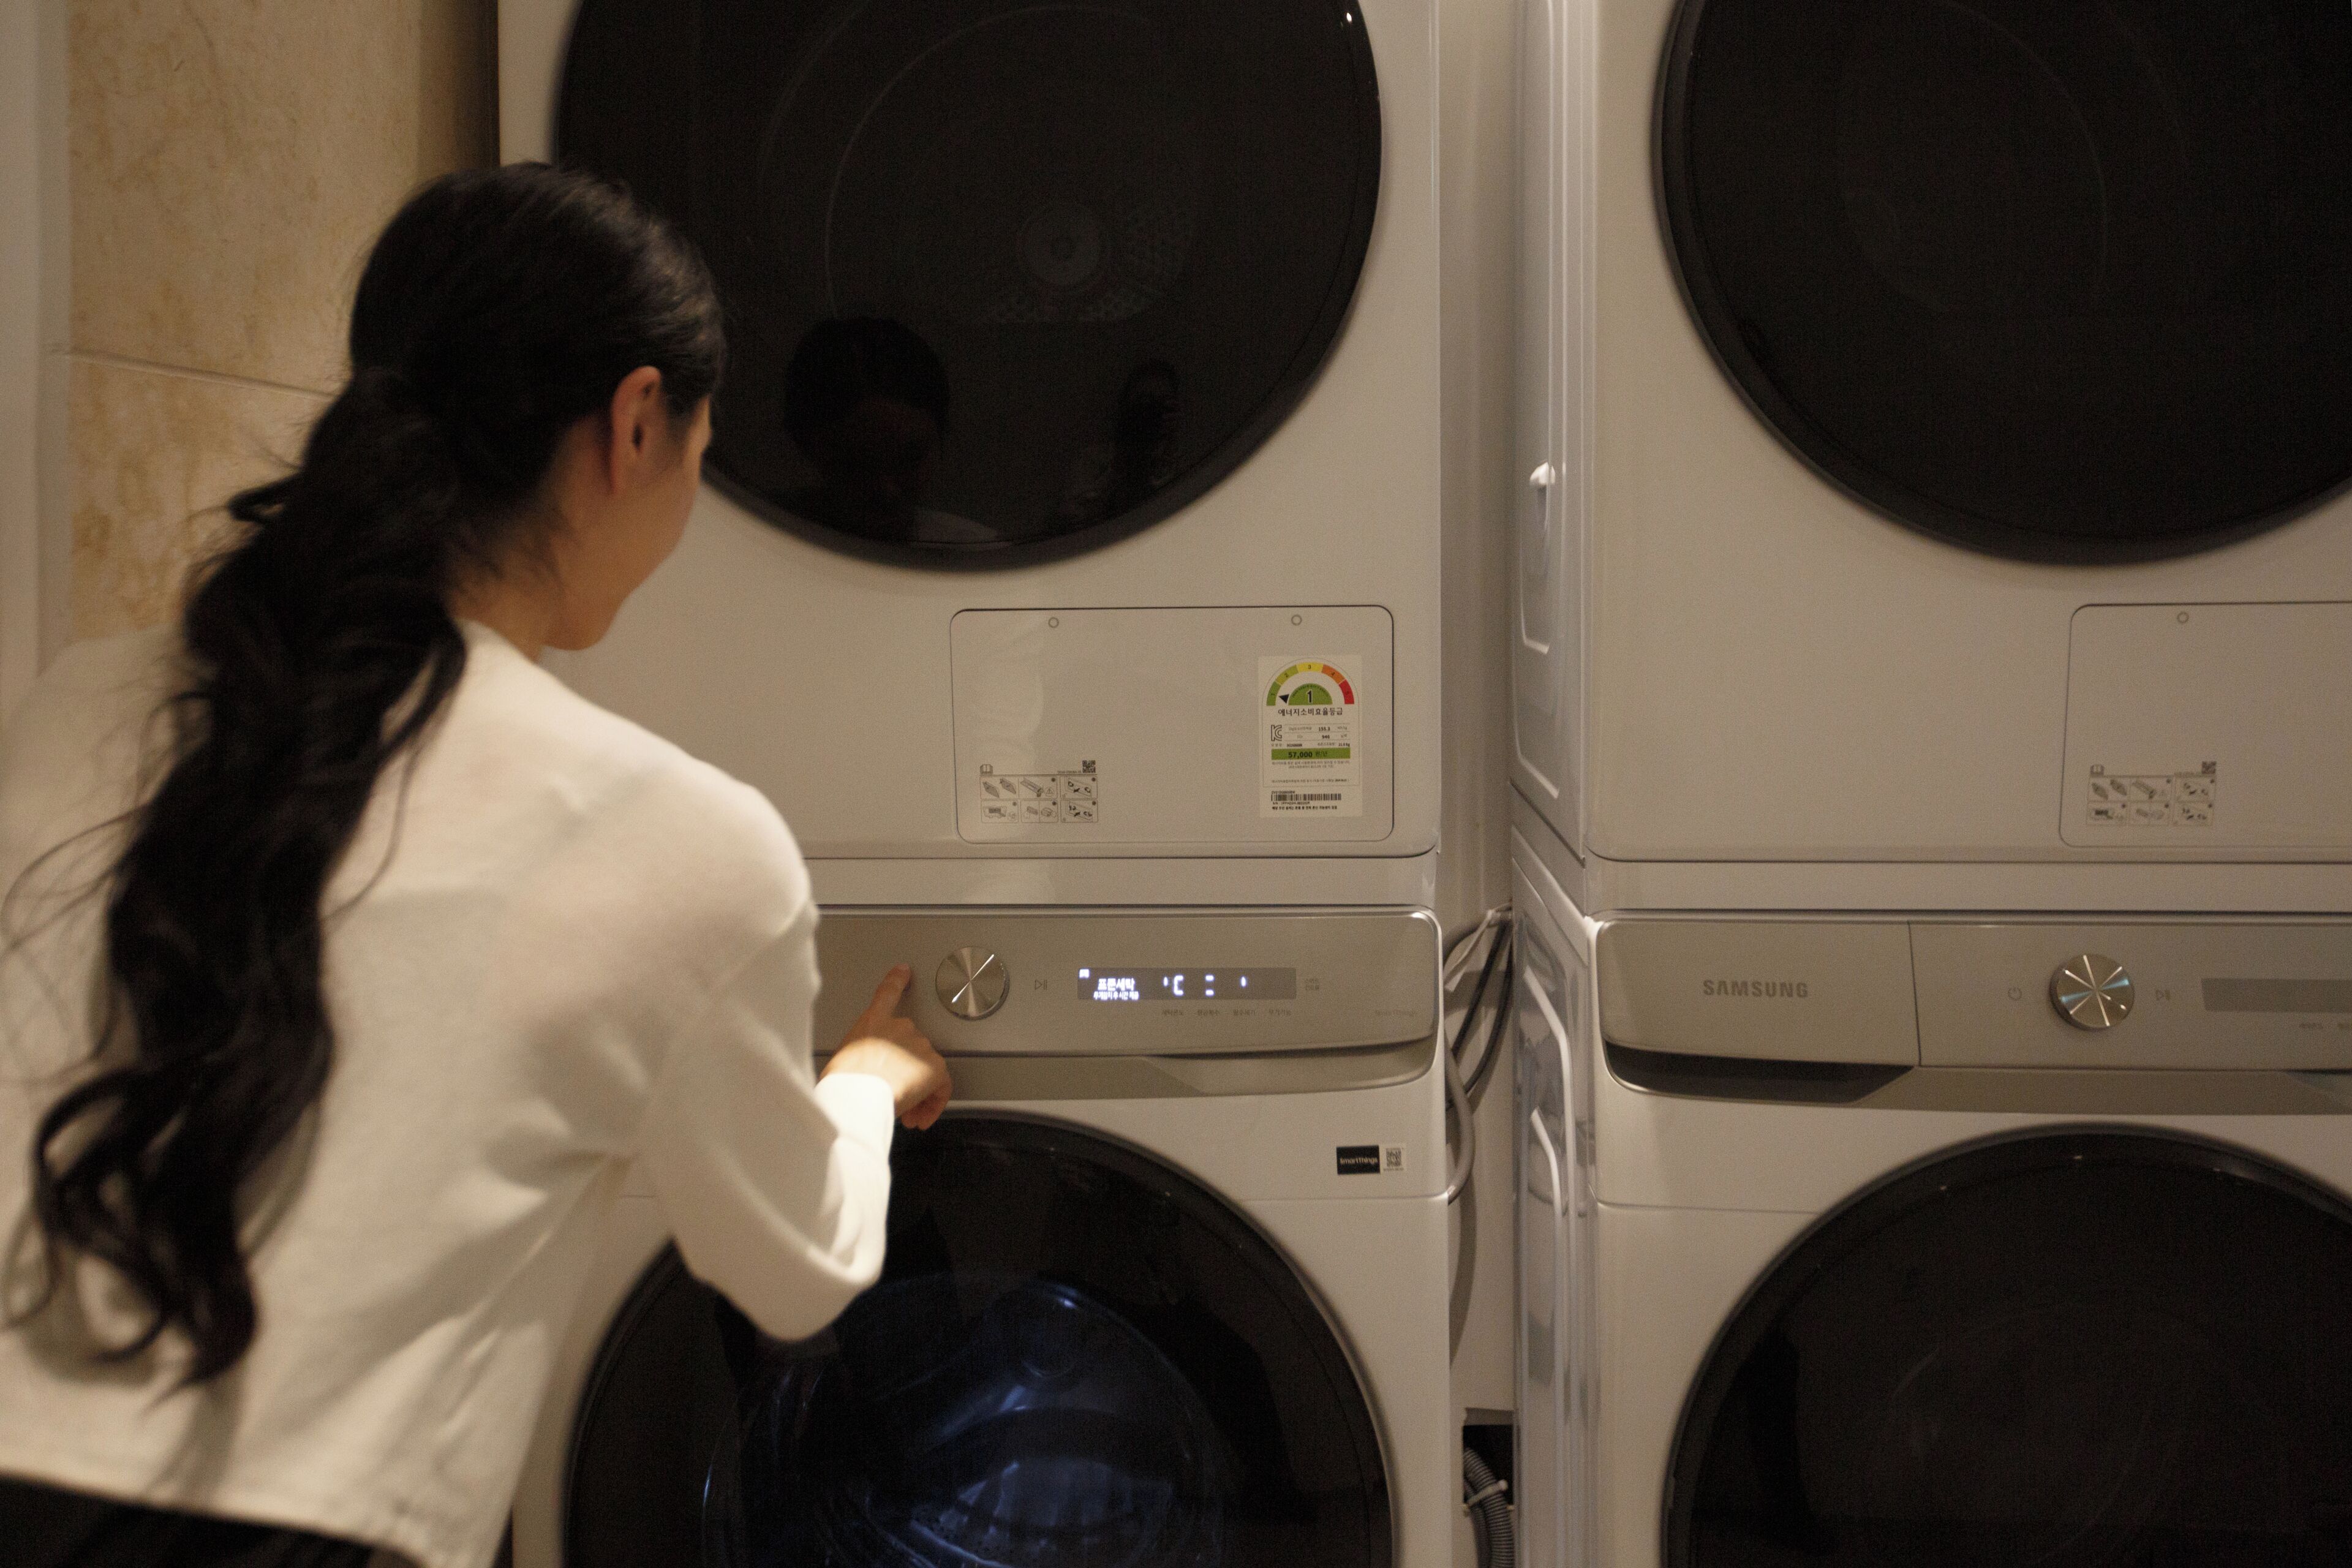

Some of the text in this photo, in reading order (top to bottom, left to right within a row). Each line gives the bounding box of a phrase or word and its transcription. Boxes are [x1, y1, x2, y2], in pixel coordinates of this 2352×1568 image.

[1307, 690, 1312, 703] 1
[1278, 707, 1343, 717] 에너지소비효율등급
[1098, 978, 1135, 991] 표준세탁
[1703, 980, 1807, 998] SAMSUNG
[1093, 991, 1112, 1000] 무게감지
[1119, 991, 1129, 1000] 시간
